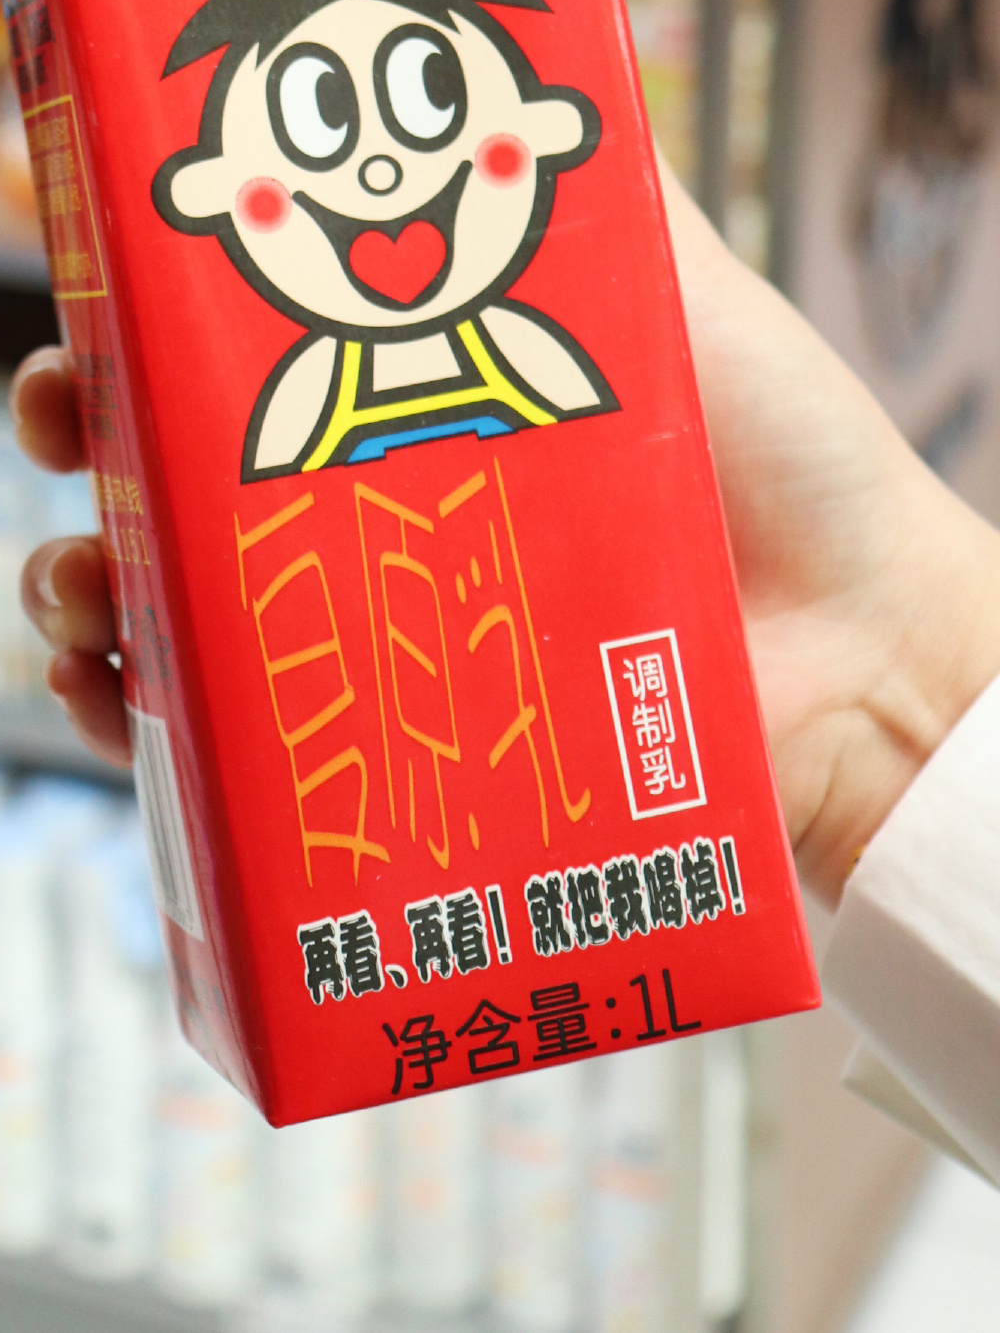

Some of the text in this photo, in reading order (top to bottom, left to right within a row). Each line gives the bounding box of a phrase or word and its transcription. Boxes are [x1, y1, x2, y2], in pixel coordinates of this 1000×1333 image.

[622, 653, 686, 796] 调制乳
[381, 968, 702, 1096] 净含量:1L
